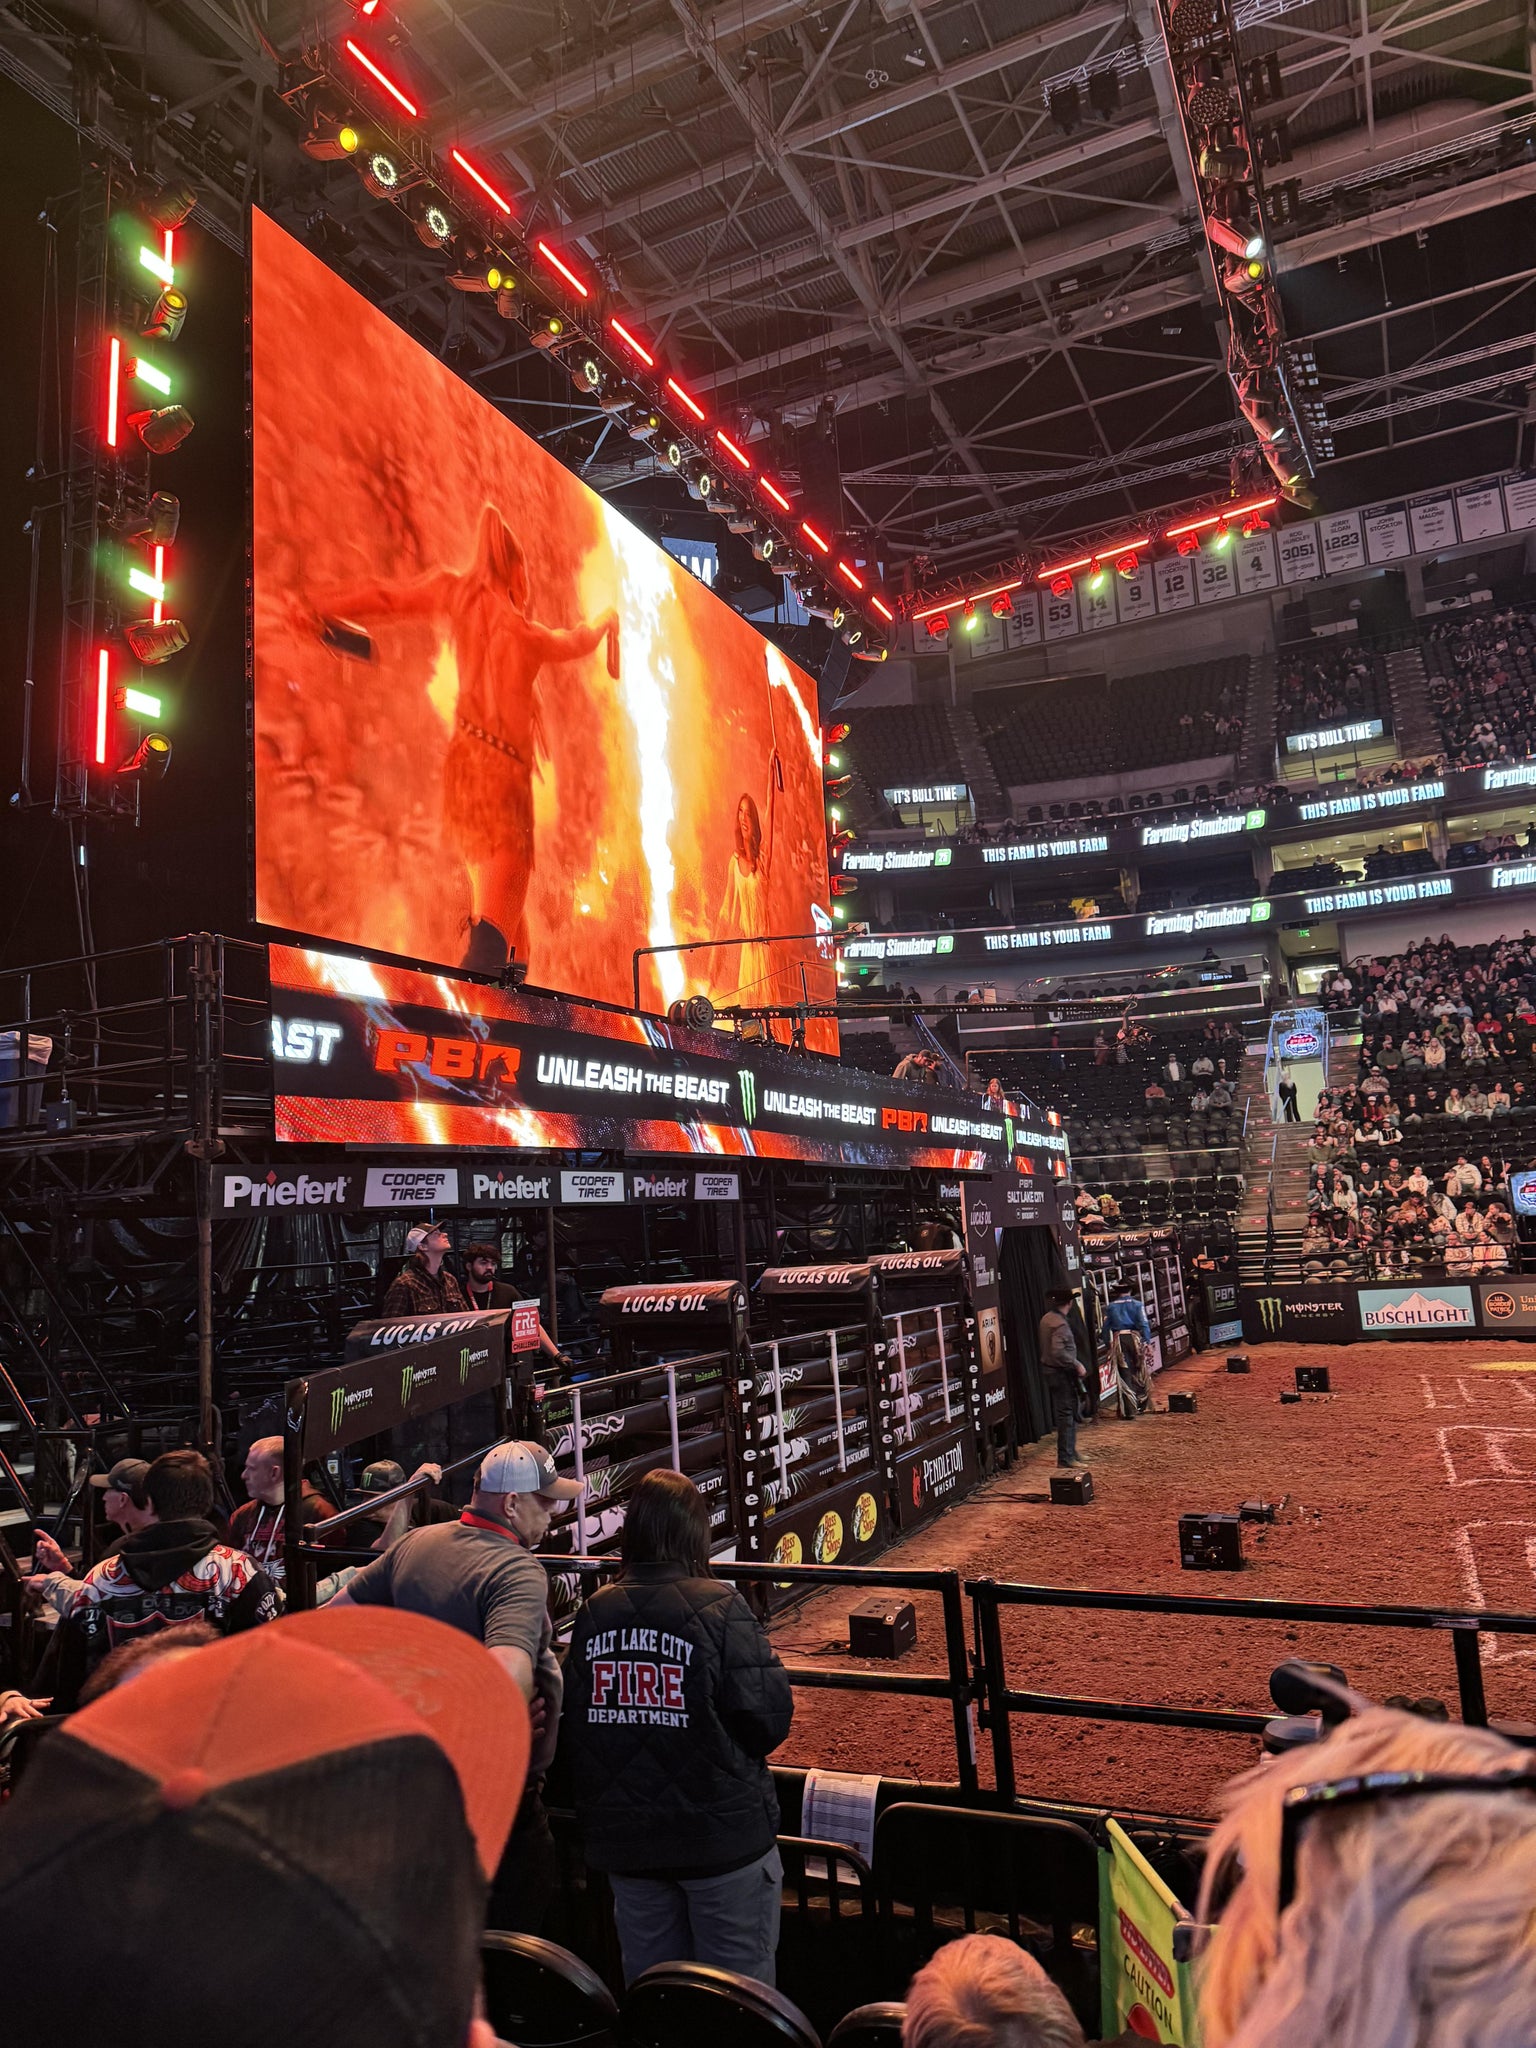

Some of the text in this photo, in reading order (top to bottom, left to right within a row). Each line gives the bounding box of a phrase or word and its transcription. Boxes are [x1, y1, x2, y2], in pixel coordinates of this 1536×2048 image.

[1325, 532, 1360, 551] 1223
[1282, 543, 1315, 560] 3051
[1250, 556, 1262, 572] 4
[1203, 564, 1228, 584] 32
[1164, 575, 1185, 594] 12
[1130, 586, 1142, 602] 9
[1012, 611, 1034, 630] 35
[1048, 603, 1072, 622] 53
[1318, 730, 1345, 747] BULL
[1346, 724, 1372, 742] TIME
[911, 788, 934, 802] BULL
[934, 786, 958, 801] TIME
[1300, 782, 1445, 820] THIS FARM IS YOUR FARM
[1143, 824, 1189, 845] Farming
[1190, 816, 1246, 838] Simulator
[982, 836, 1108, 862] THIS FARM IS YOUR FARM
[842, 852, 884, 871] Farming
[884, 850, 934, 869] Simulator
[1304, 879, 1452, 914] THIS FARM IS YOUR FARM
[1146, 914, 1193, 936] Farming
[1195, 907, 1250, 930] Simulator
[984, 925, 1112, 950] THIS FARM IS YOUR FARM
[886, 938, 936, 956] Simulator
[537, 1055, 642, 1094] UNLEASH
[644, 1072, 672, 1094] THE
[674, 1074, 730, 1104] BEAST
[764, 1090, 822, 1119] UNLEASH
[824, 1103, 840, 1119] THE
[841, 1104, 876, 1126] BEAST
[932, 1116, 970, 1136] UNLEASH
[980, 1123, 1002, 1140] BEAST
[1016, 1130, 1042, 1147] UNLEASH
[224, 1170, 346, 1208] Priefert
[382, 1174, 445, 1186] COOPER
[473, 1170, 550, 1200] Priefert
[571, 1176, 615, 1186] COOPER
[634, 1174, 688, 1198] Priefert
[702, 1176, 733, 1186] COOPER
[390, 1188, 436, 1200] TIRES
[578, 1187, 609, 1198] TIRES
[706, 1187, 729, 1196] TIRES
[1007, 1191, 1045, 1204] SALT LAKE CITY
[970, 1212, 984, 1226] LUCAS
[1090, 1238, 1104, 1246] OIL
[1152, 1230, 1166, 1238] OIL
[880, 1256, 942, 1270] LUCAS OIL
[778, 1271, 851, 1284] LUCAS OIL
[622, 1294, 707, 1313] LUCAS OIL
[1286, 1303, 1344, 1313] MONSTER
[982, 1317, 996, 1329] ARIAT
[370, 1322, 442, 1346] LUCAS
[965, 1318, 980, 1432] Priefert
[874, 1343, 894, 1479] Priefert
[844, 1424, 858, 1436] LAKE
[858, 1420, 868, 1431] CITY
[738, 1379, 758, 1550] Priefert
[923, 1441, 964, 1492] PENDLETON
[706, 1476, 722, 1492] CITY
[934, 1476, 956, 1498] WHISKY
[860, 1496, 870, 1508] Bass
[824, 1515, 836, 1530] Bass
[863, 1518, 874, 1534] Shops
[782, 1536, 795, 1552] Bass
[824, 1528, 834, 1542] Pro
[826, 1538, 840, 1556] Shops
[782, 1551, 792, 1564] Pro
[585, 1628, 694, 1666] SALT LAKE CITY
[592, 1661, 686, 1710] FIRE
[588, 1708, 689, 1728] DEPARTMENT
[1124, 1954, 1173, 2035] CAUTION
